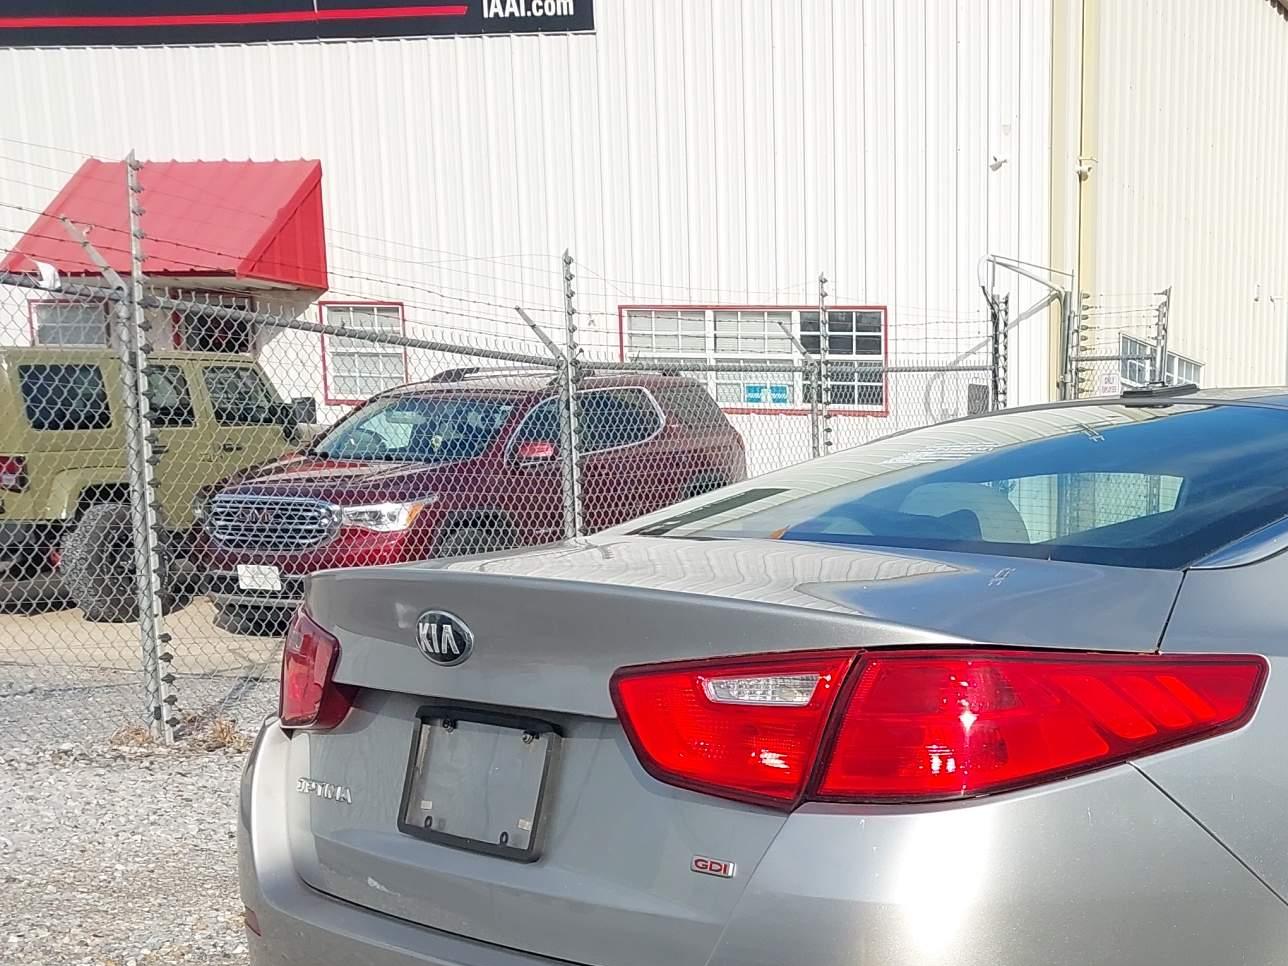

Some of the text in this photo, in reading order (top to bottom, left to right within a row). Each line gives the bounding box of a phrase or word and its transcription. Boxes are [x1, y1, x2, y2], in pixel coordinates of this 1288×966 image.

[482, 0, 574, 18] IAAI.com
[418, 622, 460, 655] KIA
[694, 858, 728, 875] GDI
